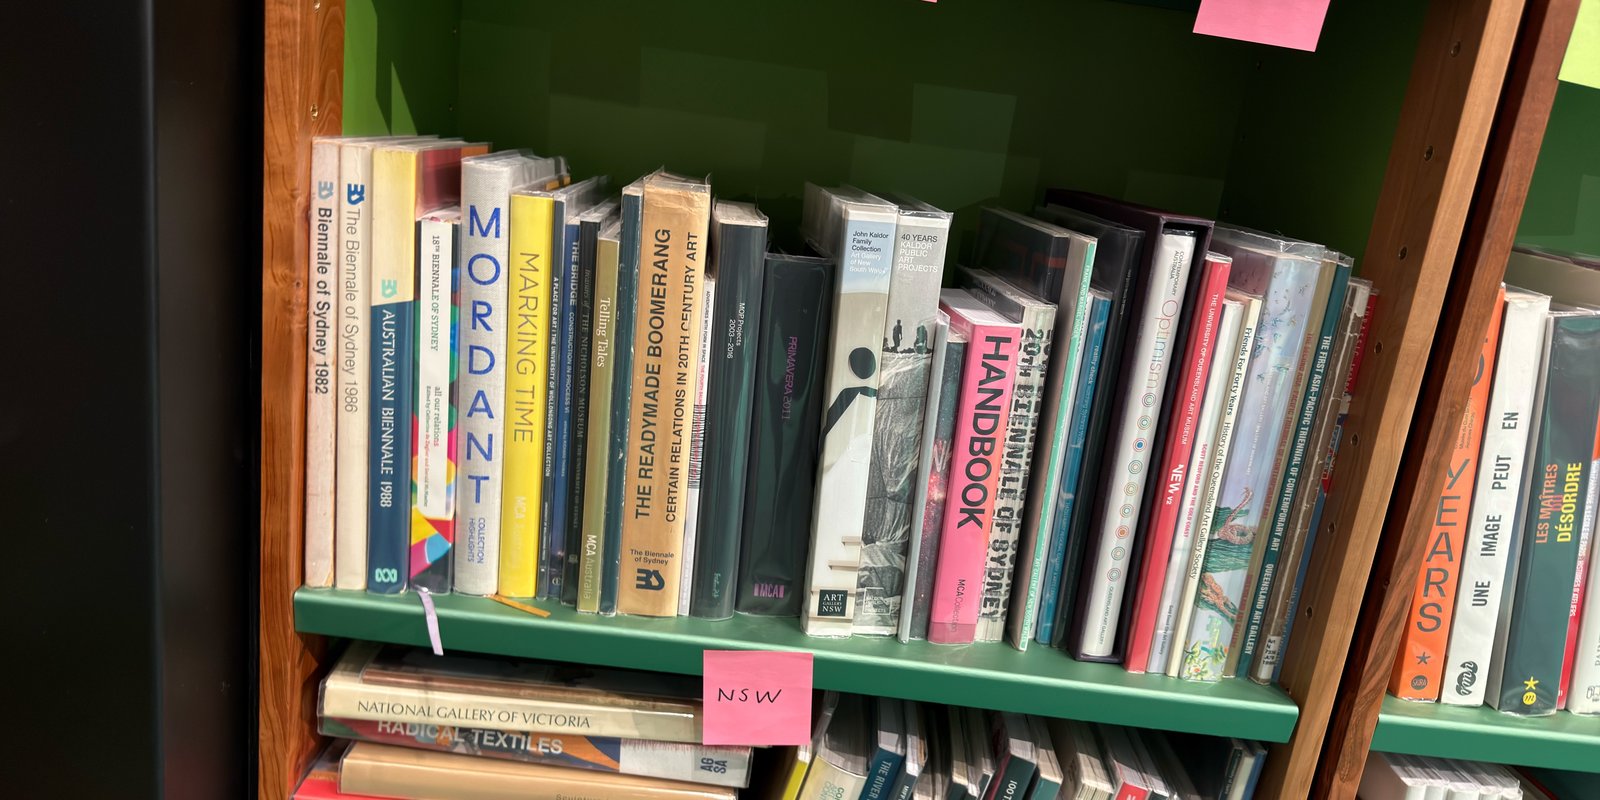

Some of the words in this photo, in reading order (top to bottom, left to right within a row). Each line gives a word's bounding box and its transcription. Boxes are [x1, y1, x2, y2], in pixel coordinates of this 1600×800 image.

[346, 208, 361, 235] The
[869, 231, 889, 239] Kaldor
[317, 207, 333, 274] Biennale
[572, 240, 580, 262] THE
[685, 231, 699, 261] ART
[851, 245, 881, 253] Collection
[852, 238, 872, 246] Family
[900, 241, 933, 250] KALDOR
[912, 234, 938, 243] YEARS
[898, 256, 915, 264] ART
[899, 249, 929, 258] PUBLIC
[1170, 251, 1180, 280] AUSTRALIA
[345, 240, 360, 301] Biennale
[431, 254, 441, 300] BIENNALE
[897, 264, 938, 273] PROJECTS
[1172, 251, 1185, 296] CONTEMPORARY
[316, 280, 331, 296] of
[570, 264, 579, 306] BRIDGE
[647, 229, 671, 358] BOOMERANG
[680, 265, 697, 331] CENTURY
[345, 306, 359, 321] of
[431, 302, 440, 314] OF
[516, 252, 540, 375] MARKING
[738, 302, 746, 319] MOP
[1210, 293, 1219, 307] THE
[313, 300, 330, 355] Sydney
[581, 313, 590, 334] THE
[596, 297, 611, 337] Telling
[1202, 308, 1215, 347] UNIVERSITY
[430, 315, 439, 351] SYDNEY
[566, 312, 575, 364] CONSTRUCTION
[735, 319, 744, 346] Projects
[1147, 300, 1179, 389] Optimism
[1239, 327, 1252, 356] Friends
[1321, 335, 1333, 350] THE
[342, 324, 359, 375] Sydney
[382, 309, 397, 401] AUSTRALIAN
[467, 204, 501, 504] MORDANT
[549, 346, 557, 380] UNIVERSITY
[596, 339, 608, 368] Tales
[678, 334, 691, 368] 20TH
[1019, 328, 1045, 378] 20TH
[1090, 345, 1099, 365] reality
[1200, 347, 1208, 358] OF
[1315, 351, 1329, 374] FIRST
[315, 361, 329, 394] 1982
[566, 365, 572, 373] IN
[578, 336, 589, 394] NICHOLSON
[676, 372, 688, 385] IN
[783, 336, 798, 395] PRIMAVERA
[1088, 366, 1096, 385] check
[1236, 358, 1246, 371] For
[434, 386, 443, 397] all
[549, 381, 555, 389] OF
[564, 374, 572, 406] PROCESS
[1191, 359, 1204, 402] QUEENSLAND
[1230, 372, 1242, 394] Forty
[344, 381, 359, 413] 1986
[547, 390, 555, 429] WOLLONGONG
[781, 396, 792, 421] 2011
[1187, 402, 1196, 415] ART
[1226, 395, 1239, 416] Years
[514, 384, 536, 443] TIME
[576, 397, 586, 439] MUSEUM
[637, 363, 662, 480] READYMADE
[671, 389, 687, 463] RELATIONS
[1501, 411, 1520, 430] EN
[381, 407, 394, 475] BIENNALE
[433, 413, 442, 447] relations
[956, 336, 1012, 529] HANDBOOK
[998, 384, 1036, 500] BIENNALE
[1182, 416, 1192, 446] MUSEUM
[1217, 422, 1232, 449] History
[545, 442, 553, 477] COLLECTION
[1217, 449, 1225, 459] of
[1292, 426, 1309, 466] TRIENNIAL
[1168, 463, 1185, 494] NEW
[1214, 458, 1224, 470] the
[1290, 466, 1300, 477] OF
[1491, 454, 1512, 490] PEUT
[380, 481, 393, 508] 1988
[635, 485, 652, 520] THE
[665, 467, 681, 523] CERTAIN
[1165, 495, 1174, 506] V2
[1192, 485, 1200, 497] AND
[1205, 471, 1221, 513] Queensland
[1537, 464, 1559, 520] MAÎTRES
[1555, 461, 1583, 543] DÉSORDRE
[514, 496, 526, 518] MCA
[995, 506, 1015, 535] OF
[1202, 515, 1212, 527] Art
[1274, 478, 1297, 537] CONTEMPORARY
[467, 518, 476, 562] HIGHLIGHTS
[476, 517, 486, 564] COLLECTION
[585, 534, 597, 556] MCA
[1194, 528, 1208, 553] Gallery
[1270, 537, 1282, 552] ART
[1480, 514, 1502, 557] IMAGE
[1535, 522, 1549, 544] LES
[643, 558, 669, 566] Sydney
[644, 550, 675, 559] Biennale
[1188, 553, 1203, 580] Society
[583, 556, 595, 600] Australia
[956, 578, 967, 596] MCA
[981, 539, 1010, 623] SYDNEY
[1256, 563, 1274, 609] QUEENSLAND
[823, 593, 844, 602] ART
[1472, 580, 1491, 607] UNE
[951, 596, 964, 633] Collection
[1252, 610, 1263, 624] ART
[1245, 625, 1259, 655] GALLERY
[718, 687, 782, 703] NSW
[357, 700, 433, 718] NATIONAL
[437, 706, 495, 722] GALLERY
[497, 709, 518, 722] OF
[522, 711, 591, 728] VICTORIA
[377, 719, 465, 742] RADICAL
[471, 728, 564, 754] TEXTILES
[700, 757, 714, 773] AG
[713, 760, 728, 774] SA
[880, 761, 892, 777] THE
[869, 776, 885, 800] RIVER
[1006, 780, 1018, 795] 100
